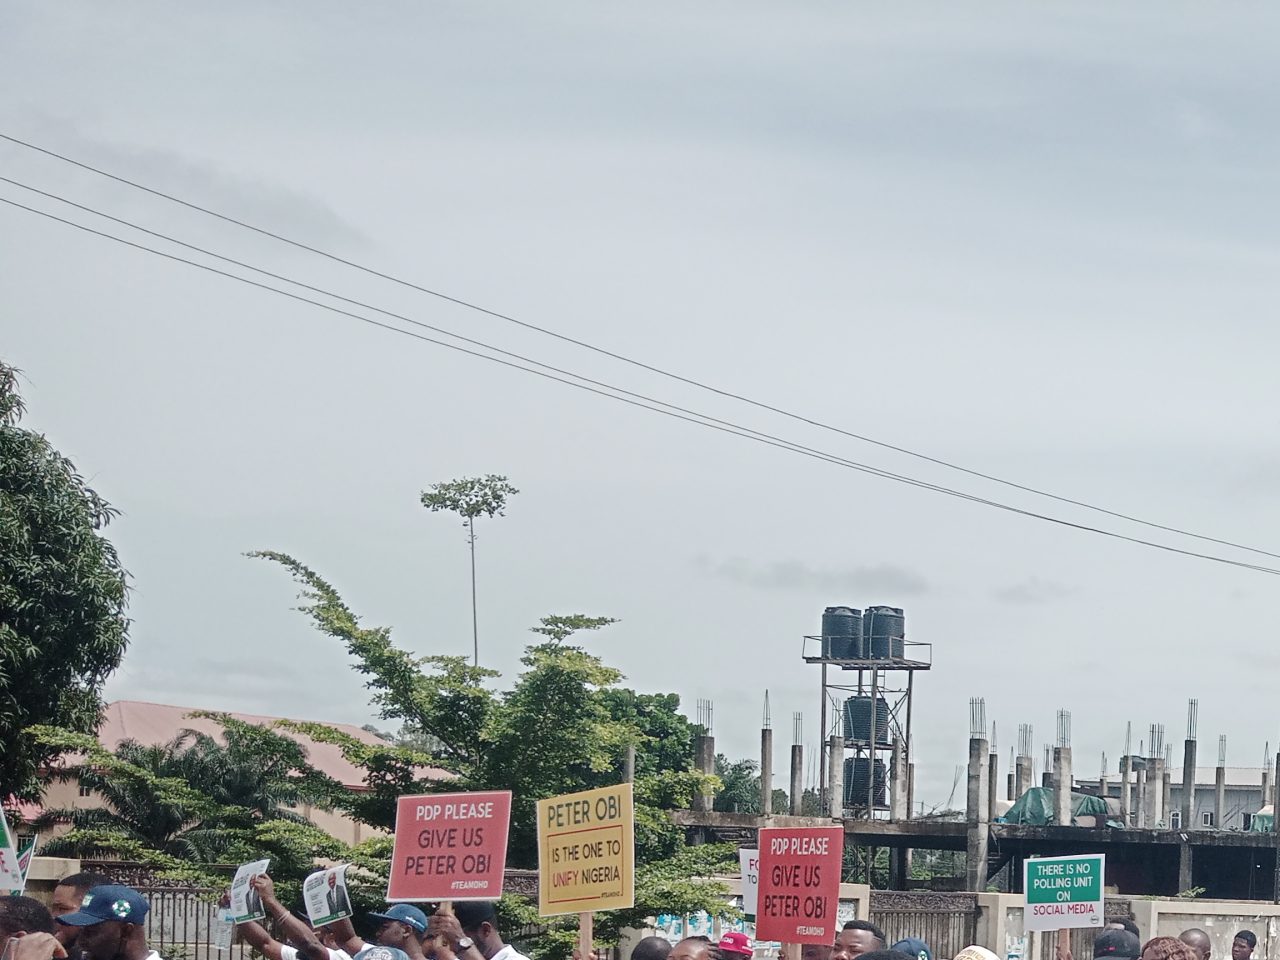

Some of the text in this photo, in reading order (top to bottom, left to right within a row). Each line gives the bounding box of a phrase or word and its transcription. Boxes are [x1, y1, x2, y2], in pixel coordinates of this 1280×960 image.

[416, 802, 494, 821] PDP PLEASE
[548, 795, 621, 828] PETER OBI
[418, 828, 483, 848] GIVE US
[771, 837, 830, 855] PDP PLEASE
[552, 840, 621, 863] IS THE ONE TO
[405, 854, 491, 875] PETER OBI
[1037, 863, 1090, 875] THERE IS NO
[552, 865, 621, 888] UNIFY NIGERIA
[772, 865, 820, 887] GIVE US
[1034, 877, 1093, 889] POLLING UNIT
[1056, 891, 1070, 901] ON
[764, 895, 827, 918] PETER OBI
[1033, 904, 1094, 915] SOCIAL MEDIA
